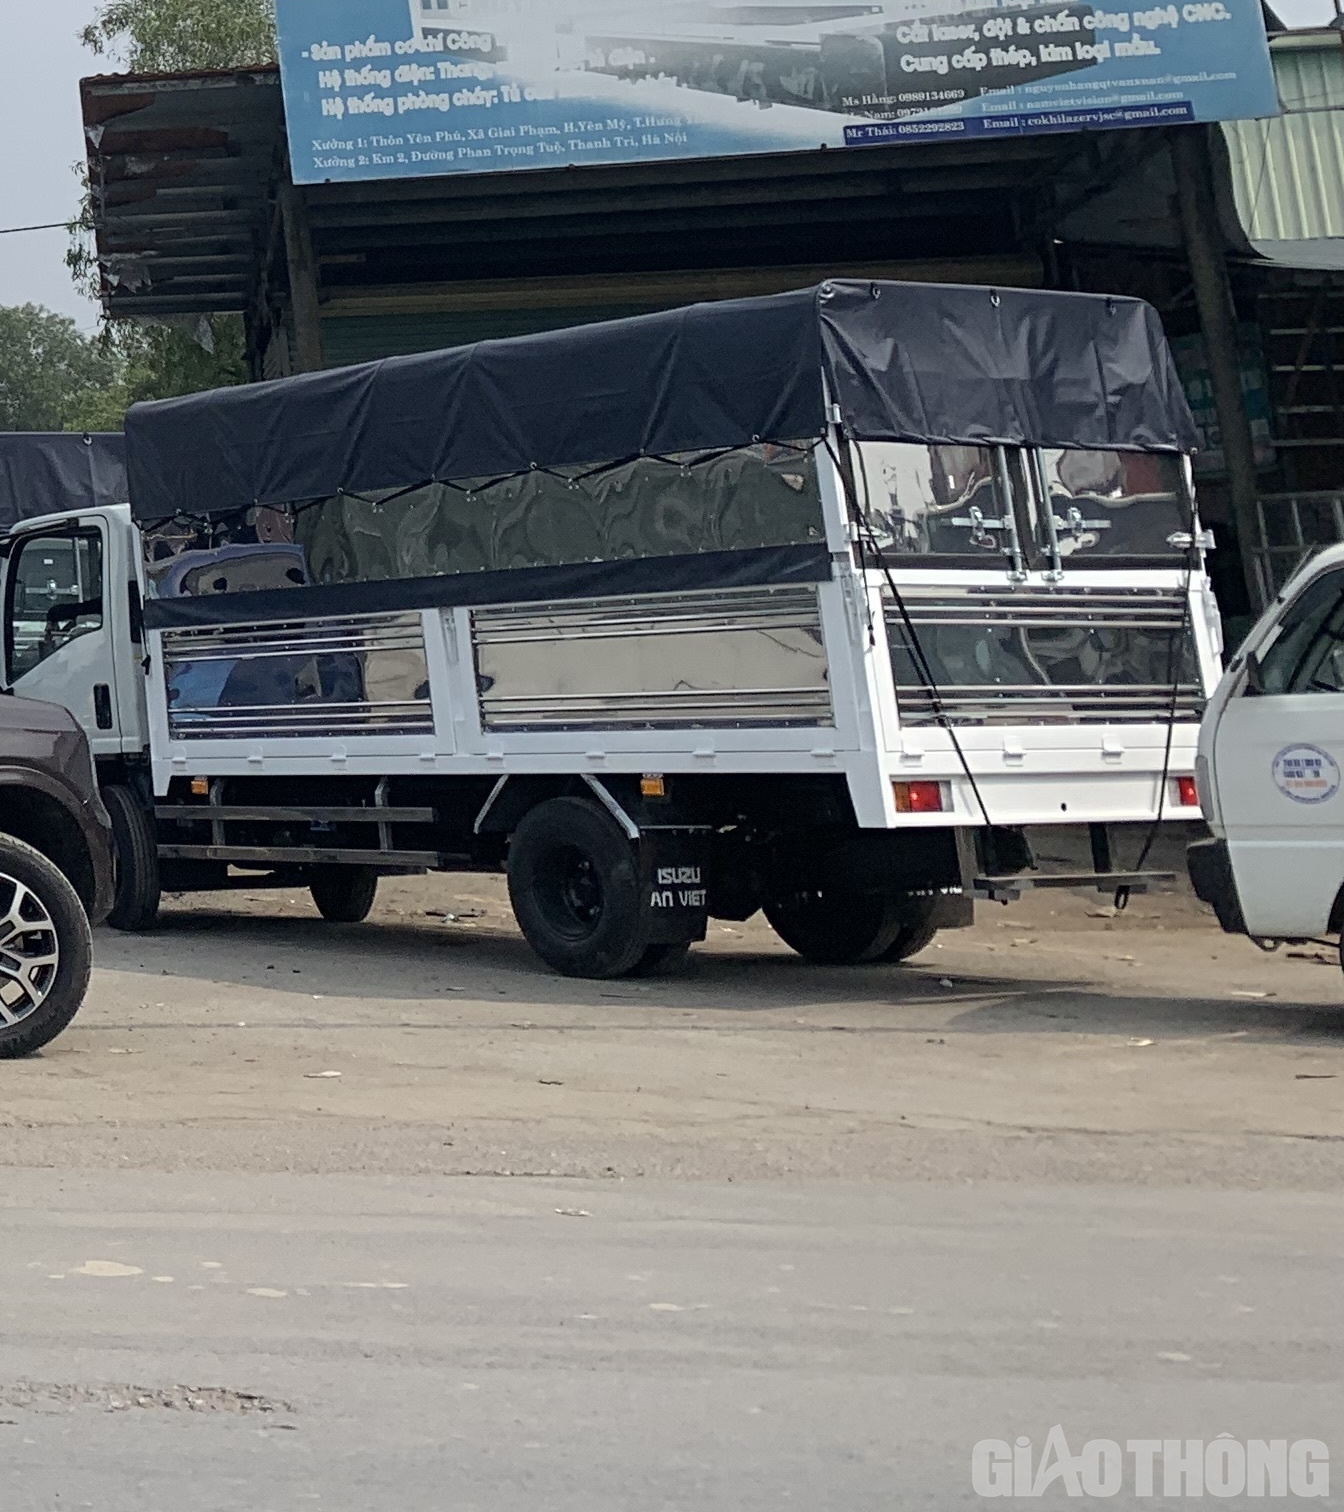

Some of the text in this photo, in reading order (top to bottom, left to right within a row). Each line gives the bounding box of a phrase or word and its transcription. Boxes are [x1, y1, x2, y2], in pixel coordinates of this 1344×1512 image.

[981, 16, 1014, 41] đột
[1015, 16, 1031, 34] &
[1031, 8, 1080, 33] chấn
[1081, 7, 1131, 34] công
[1131, 3, 1180, 31] nghệ
[1181, 0, 1233, 23] CNC.
[445, 29, 492, 54] Công
[899, 51, 950, 77] Cung
[949, 44, 989, 73] cấp
[988, 43, 1038, 69] thép,
[1038, 42, 1073, 62] kim
[1074, 39, 1113, 64] loại
[317, 68, 342, 92] Hệ
[343, 62, 392, 90] thống
[393, 61, 436, 87] điện:
[841, 96, 859, 106] Ms
[978, 85, 1015, 96] Email
[320, 96, 345, 121] Hệ
[346, 90, 395, 119] thống
[396, 87, 450, 115] phòng
[451, 84, 498, 109] cháy:
[981, 101, 1017, 112] Email
[845, 128, 863, 138] Mr
[982, 117, 1020, 128] Email
[310, 136, 354, 152] Xưởng
[369, 134, 404, 146] Thôn
[406, 131, 431, 144] Yên
[434, 129, 465, 143] Phú,
[466, 128, 485, 139] Xã
[487, 126, 515, 138] Giai
[518, 122, 560, 138] Phạm,
[563, 119, 603, 133] H.Yên
[312, 154, 356, 170] Xưởng
[371, 152, 394, 164] Km
[396, 152, 408, 164] 2,
[410, 147, 454, 163] Đường
[457, 145, 492, 158] Phan
[494, 142, 534, 157] Trọng
[536, 140, 565, 155] Tuệ,
[567, 137, 611, 150] Thanh
[640, 133, 660, 145] Hà
[663, 131, 688, 146] Nội
[658, 867, 700, 884] ISUZU
[650, 889, 706, 907] AN VIET
